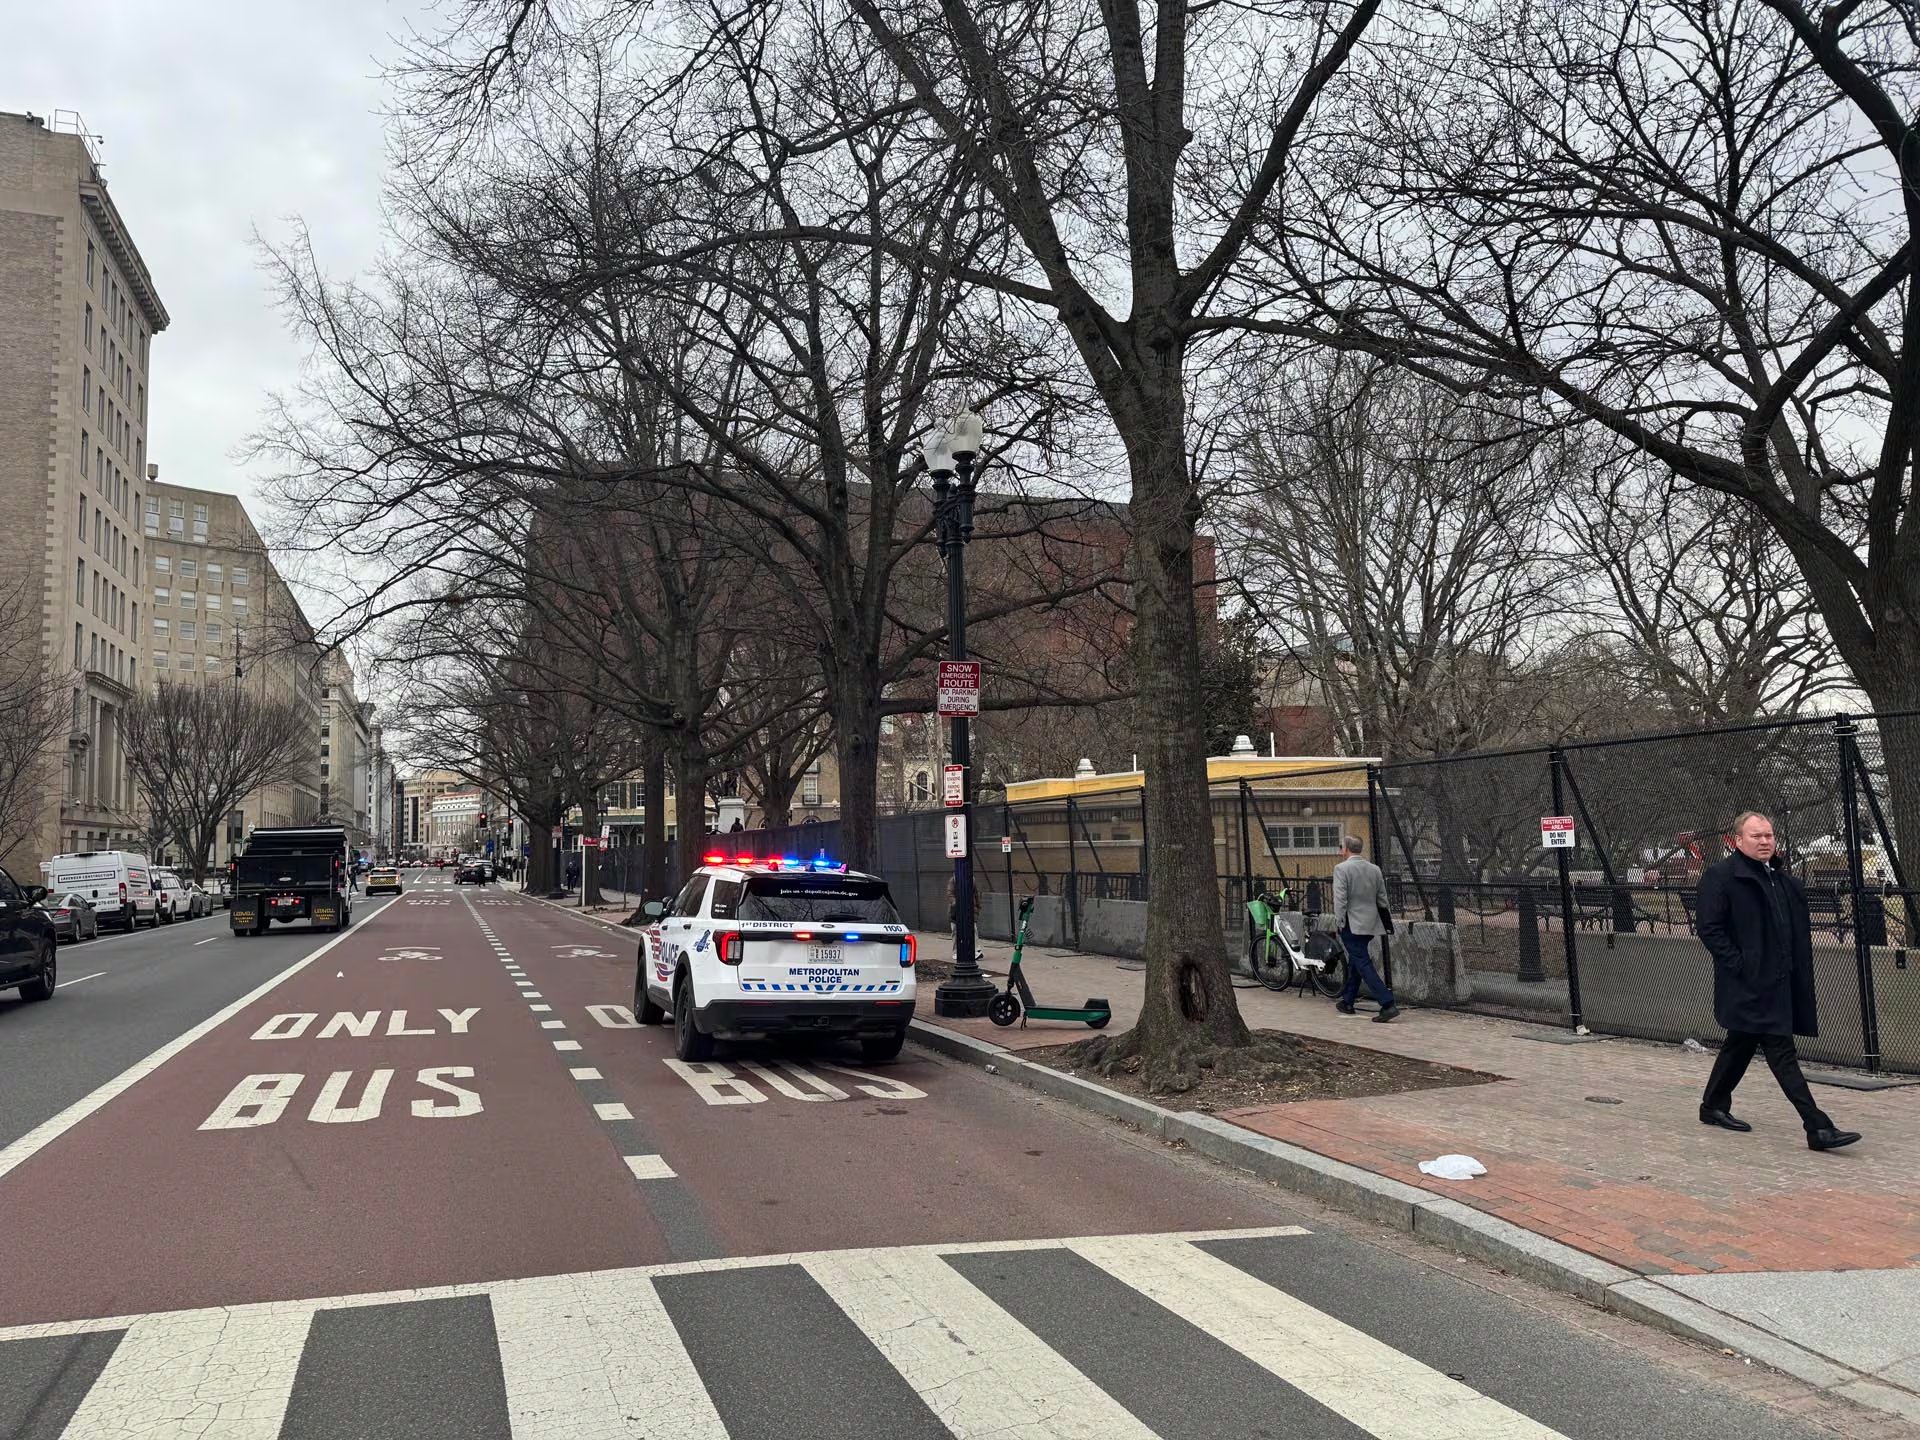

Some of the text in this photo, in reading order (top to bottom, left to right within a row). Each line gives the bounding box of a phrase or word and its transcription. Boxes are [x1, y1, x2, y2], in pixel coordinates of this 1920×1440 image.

[946, 664, 973, 673] SNOW
[943, 679, 975, 687] ROUTE
[940, 688, 977, 696] NO PARKING
[940, 703, 977, 711] EMERGENCY
[820, 949, 841, 959] 15937
[789, 968, 860, 976] METROPOLITAN
[808, 976, 842, 984] POLICE
[250, 1008, 481, 1040] ONLY
[196, 1066, 484, 1130] BUS
